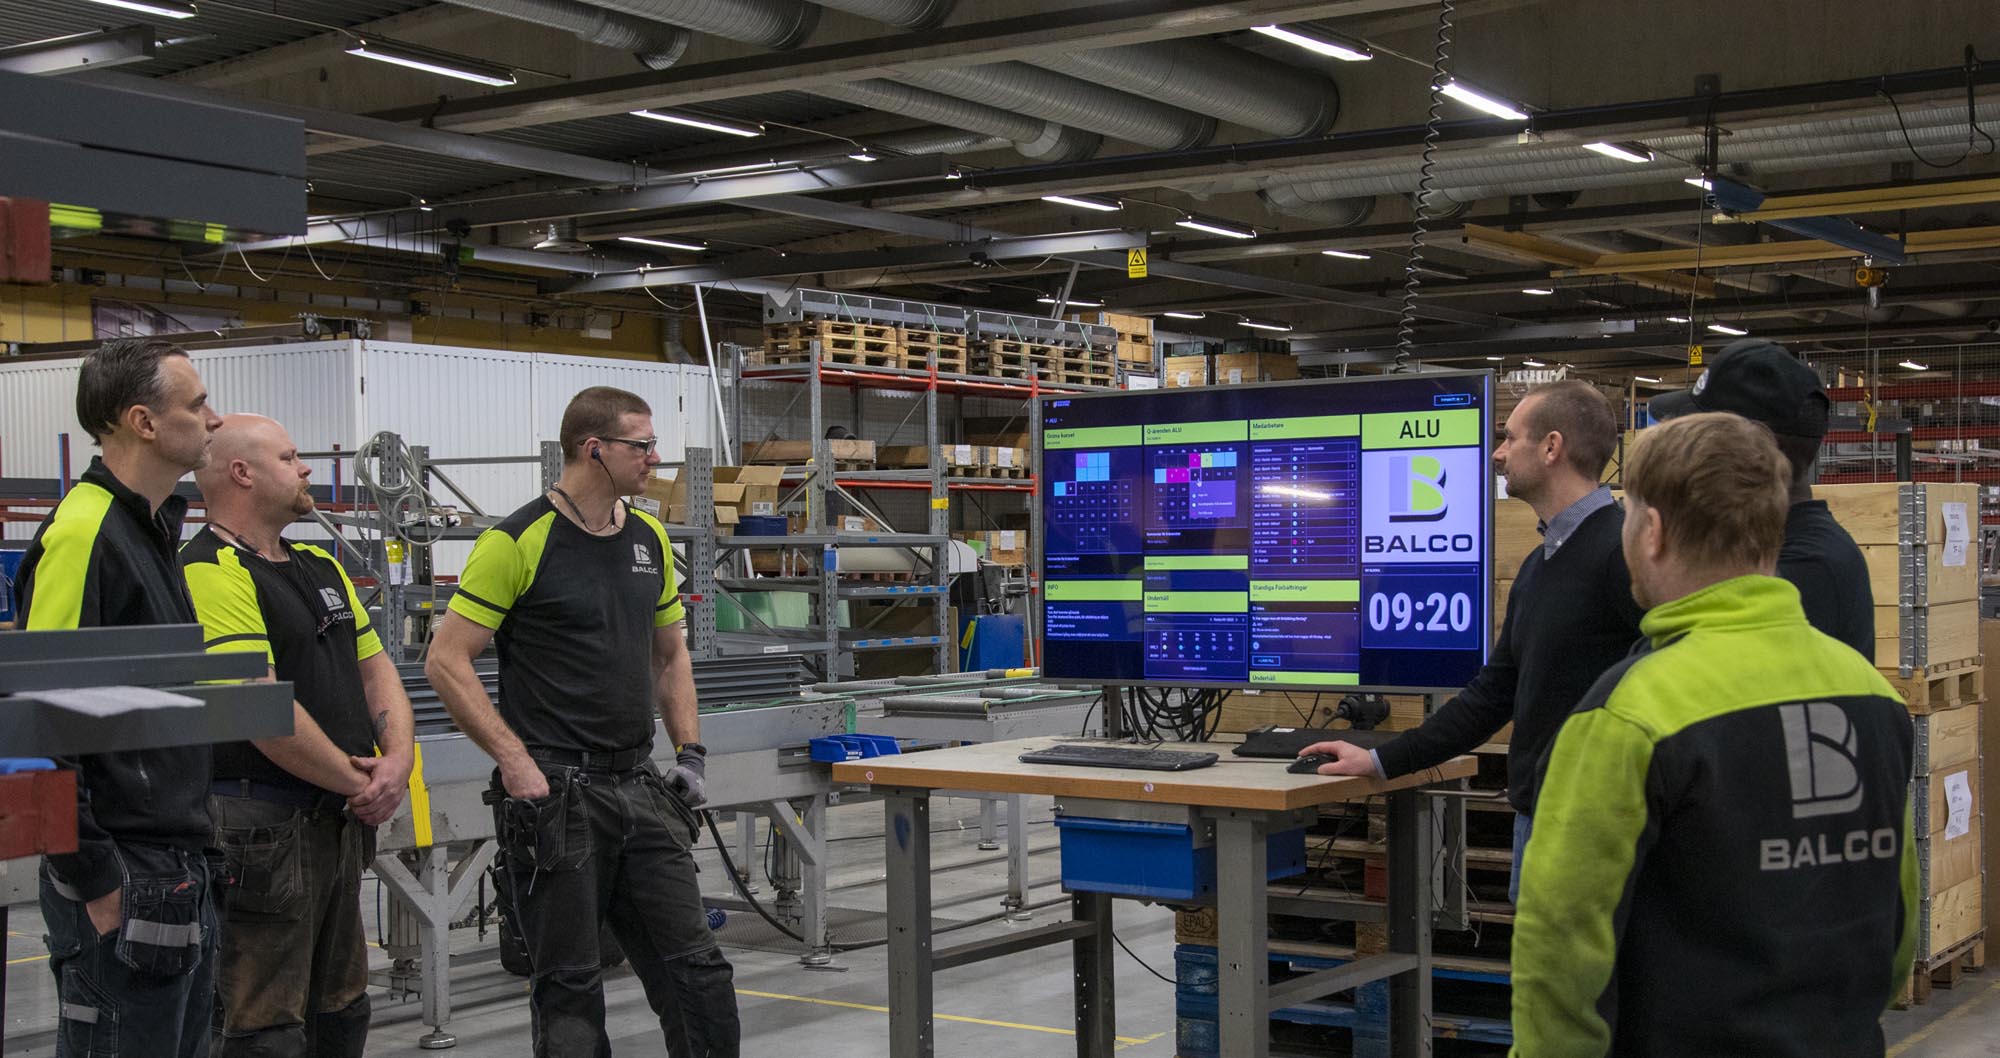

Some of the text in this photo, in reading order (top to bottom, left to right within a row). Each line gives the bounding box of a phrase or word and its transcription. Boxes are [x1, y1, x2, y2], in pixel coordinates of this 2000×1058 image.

[1400, 419, 1440, 439] ALU
[1365, 534, 1473, 553] BALCO
[1369, 592, 1471, 632] 09:20
[1760, 828, 1896, 871] BALCO
